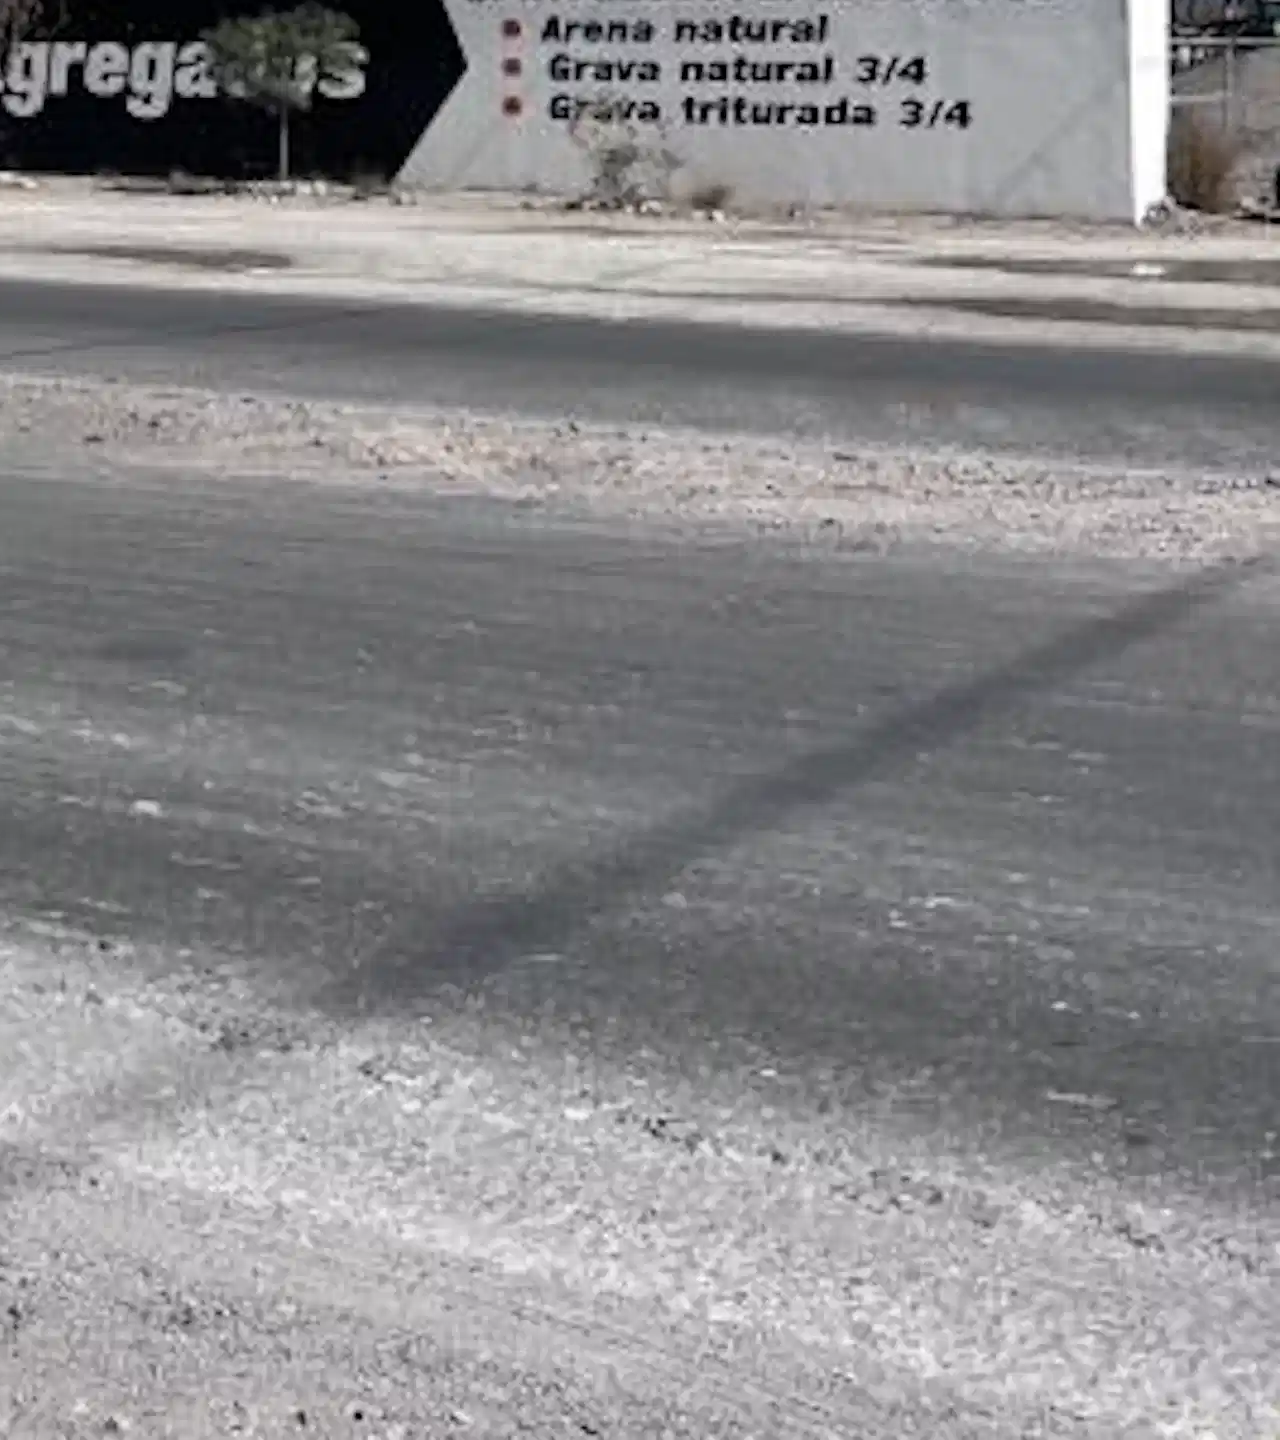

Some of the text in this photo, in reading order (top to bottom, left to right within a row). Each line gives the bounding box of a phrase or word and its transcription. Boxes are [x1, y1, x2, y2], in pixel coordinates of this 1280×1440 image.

[541, 15, 828, 43] Arena natural
[548, 54, 927, 84] Grava natural 3/4
[681, 96, 874, 125] triturada
[899, 100, 971, 128] 3/4
